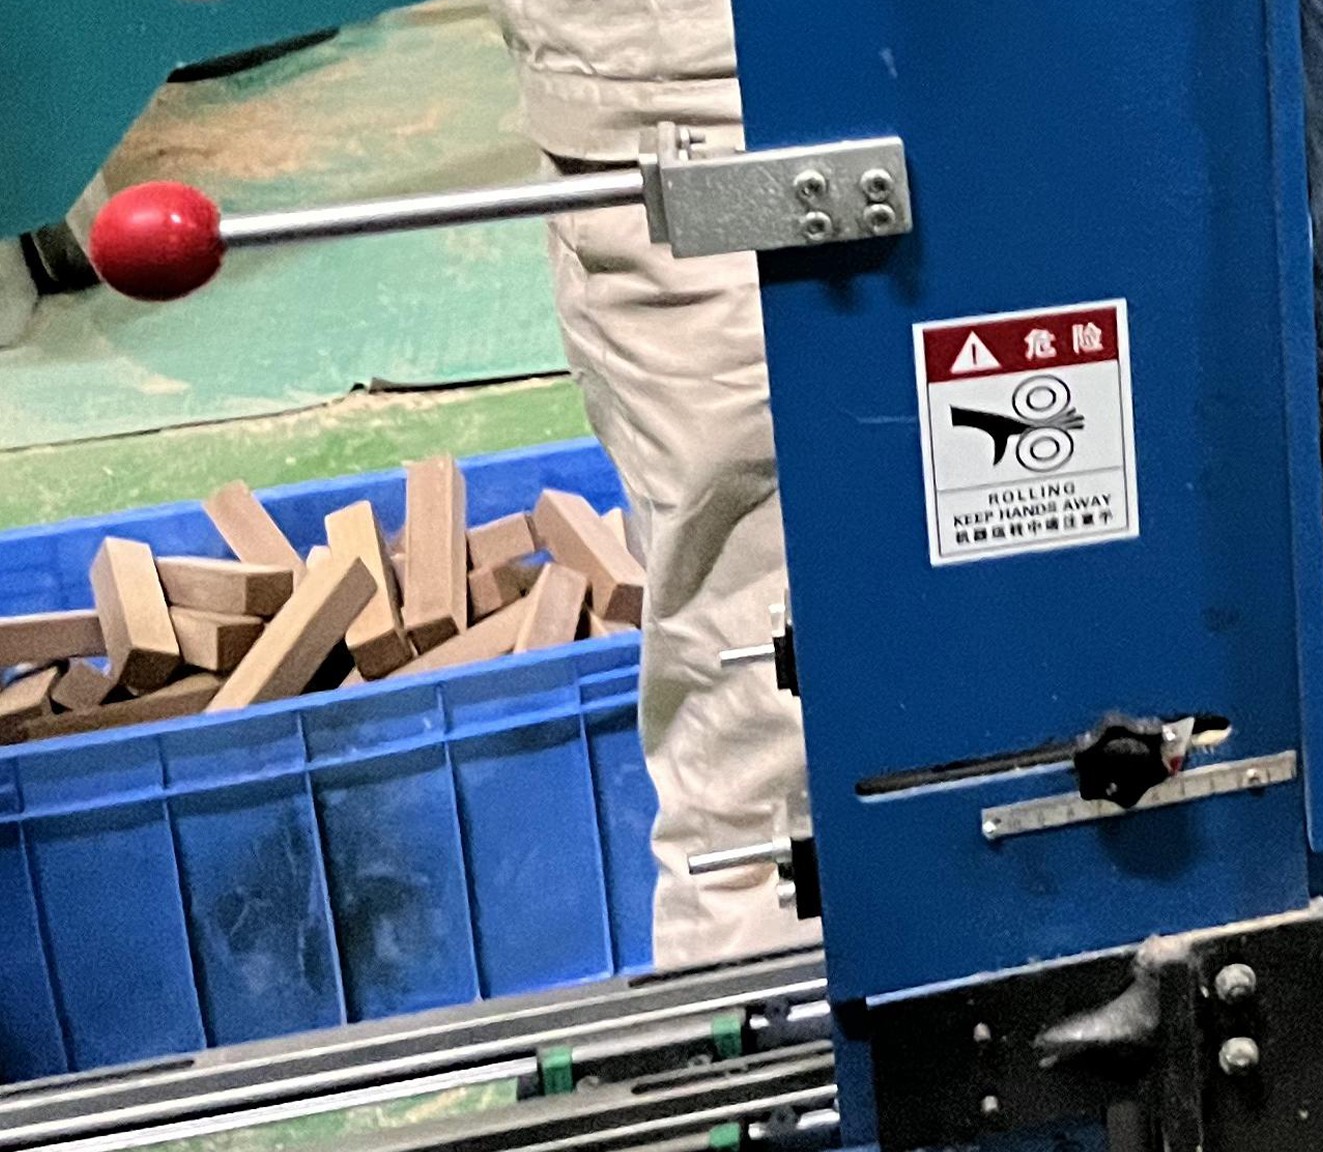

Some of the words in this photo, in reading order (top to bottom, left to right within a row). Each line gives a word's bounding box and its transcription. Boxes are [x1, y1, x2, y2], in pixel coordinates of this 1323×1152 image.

[1023, 322, 1103, 360] 危险
[953, 511, 993, 528] KEEP
[1063, 493, 1111, 512] AWAY
[988, 481, 1075, 505] ROLLING
